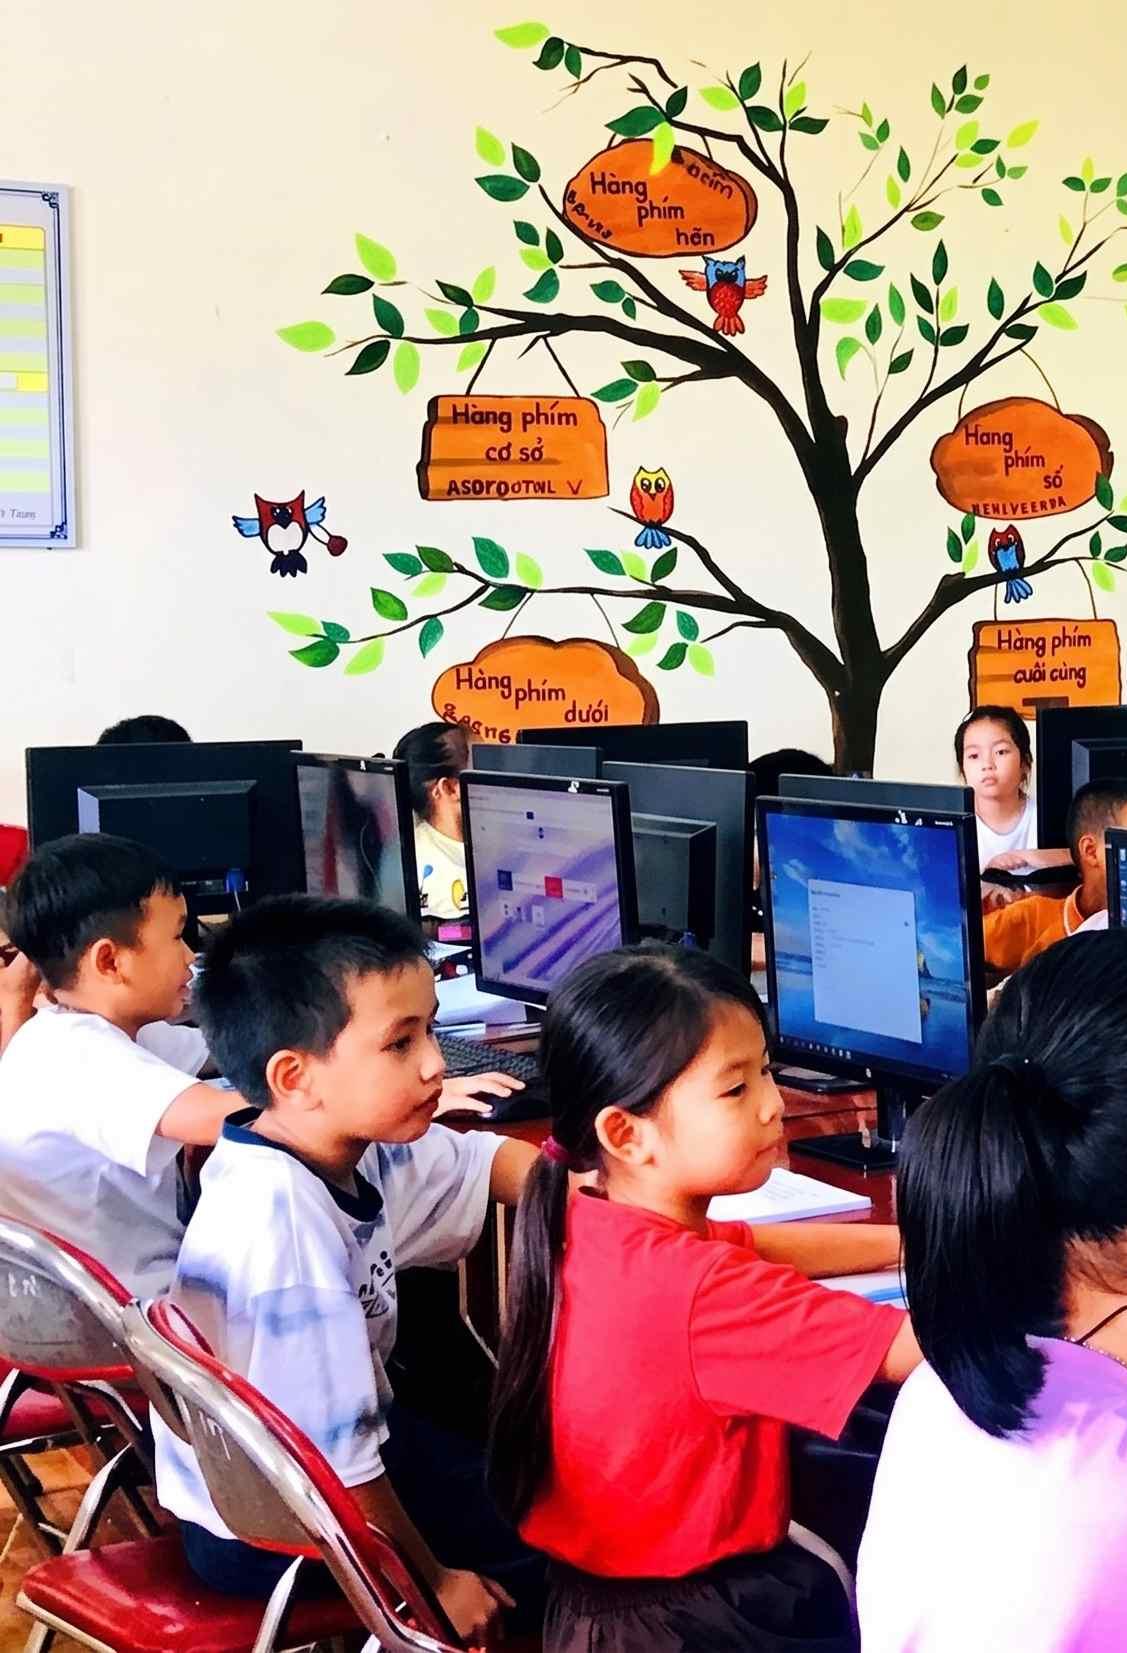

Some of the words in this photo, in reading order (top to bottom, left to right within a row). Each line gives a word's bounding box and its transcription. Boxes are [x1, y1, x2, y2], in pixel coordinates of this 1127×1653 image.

[590, 171, 648, 203] Hàng
[636, 195, 686, 227] phím
[452, 403, 512, 433] Hàng
[522, 401, 578, 432] phím
[1003, 445, 1046, 477] phím
[996, 627, 1046, 658] Hàng
[1051, 625, 1092, 656] phím
[455, 667, 512, 699] Hàng
[1049, 666, 1087, 689] cùng
[514, 679, 566, 710] phím
